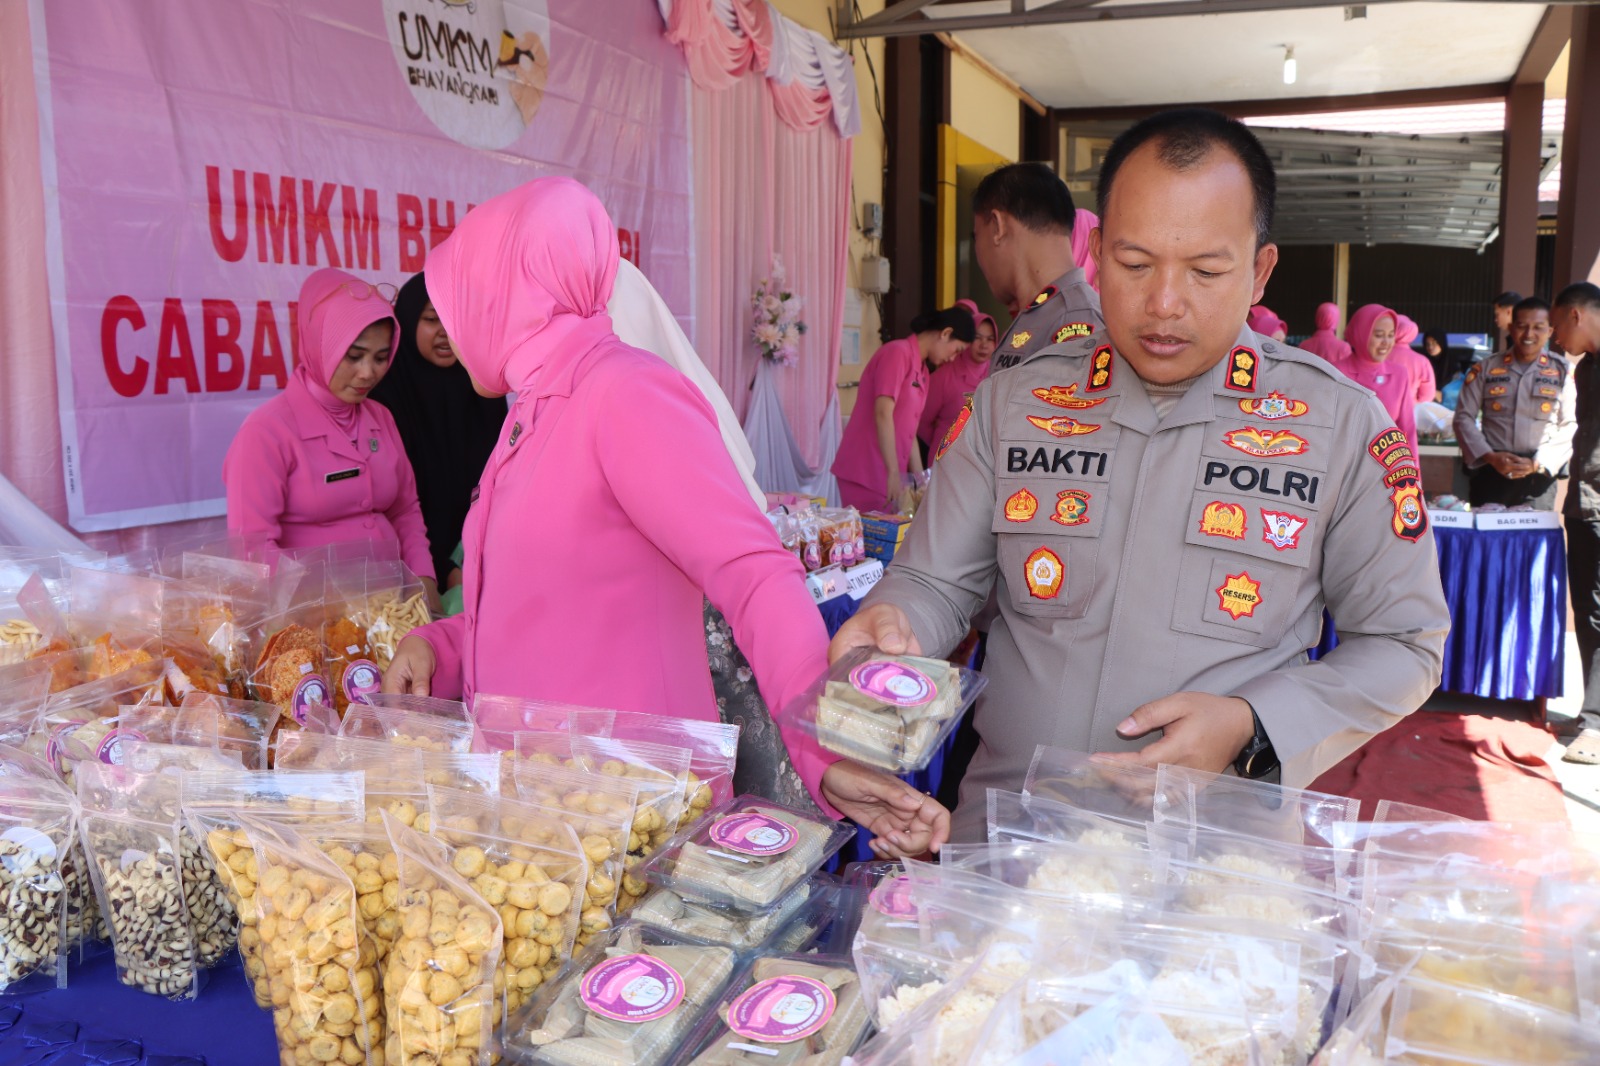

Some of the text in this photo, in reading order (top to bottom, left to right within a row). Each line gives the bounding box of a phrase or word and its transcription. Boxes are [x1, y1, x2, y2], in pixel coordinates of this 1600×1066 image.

[399, 11, 494, 78] UMKM
[407, 66, 499, 105] BHAYANGKARI
[205, 165, 380, 270] UMKM
[101, 294, 300, 397] CABA
[1007, 447, 1107, 476] BAKTI
[1204, 461, 1319, 504] POLRI
[1210, 527, 1235, 536] POLRI
[1434, 515, 1458, 523] SDM
[1222, 588, 1257, 603] RESERSE
